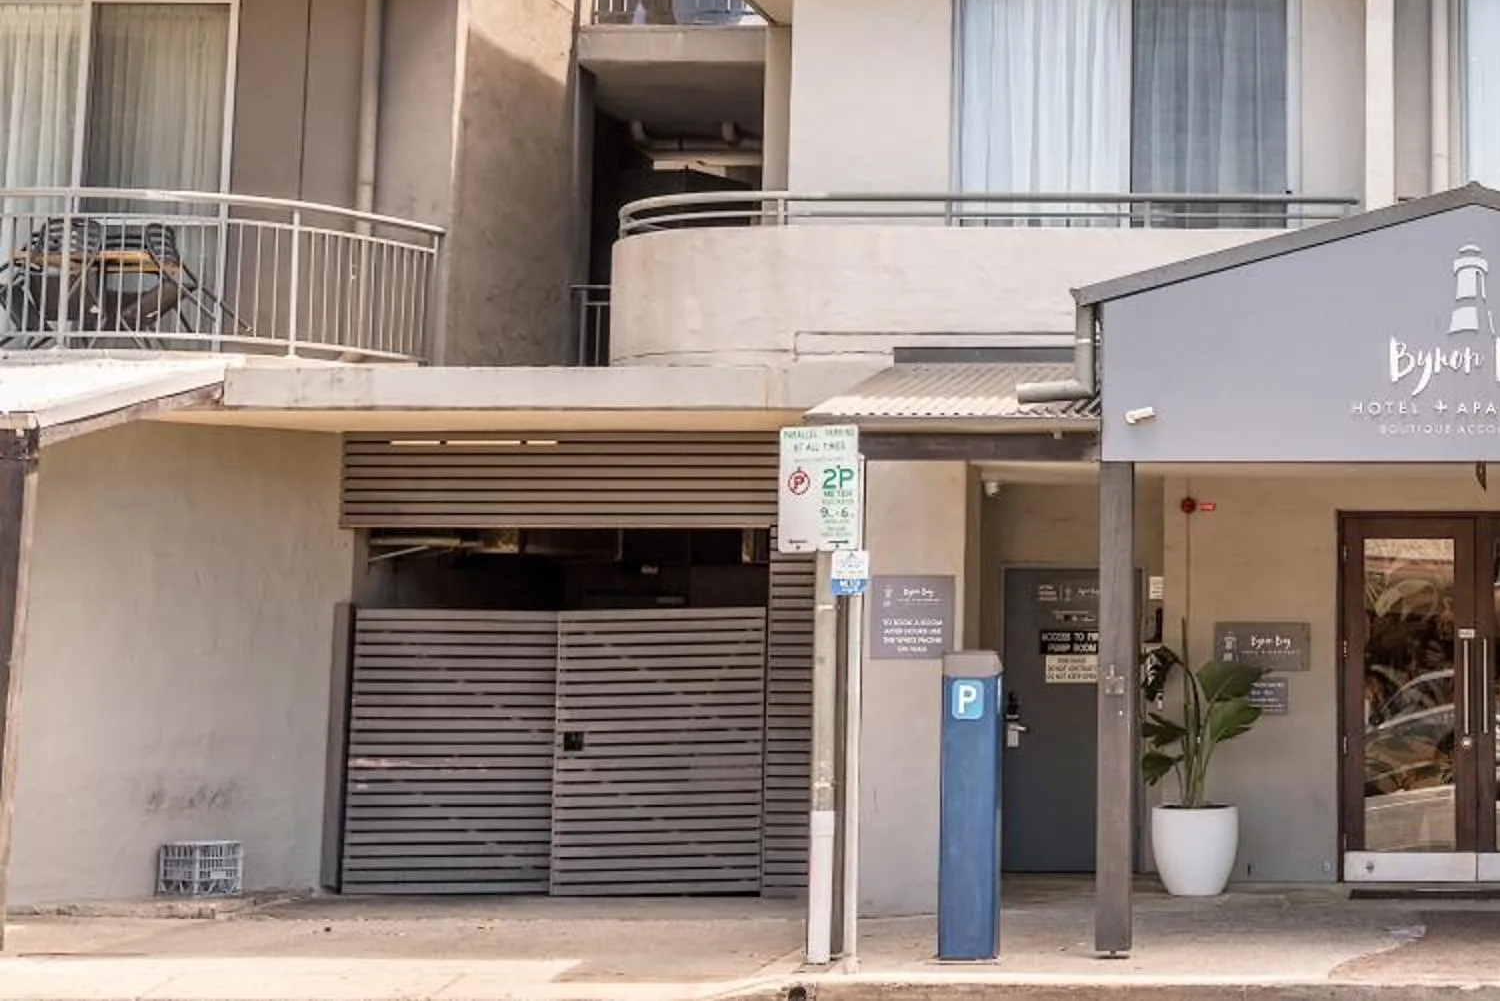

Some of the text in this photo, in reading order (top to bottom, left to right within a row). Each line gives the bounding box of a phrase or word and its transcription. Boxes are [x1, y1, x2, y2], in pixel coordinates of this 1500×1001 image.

[1390, 337, 1484, 397] Byron
[1351, 401, 1419, 415] HOTEL
[1380, 424, 1451, 435] BOUTIQUE
[822, 468, 855, 490] 2P
[1073, 632, 1085, 642] TO
